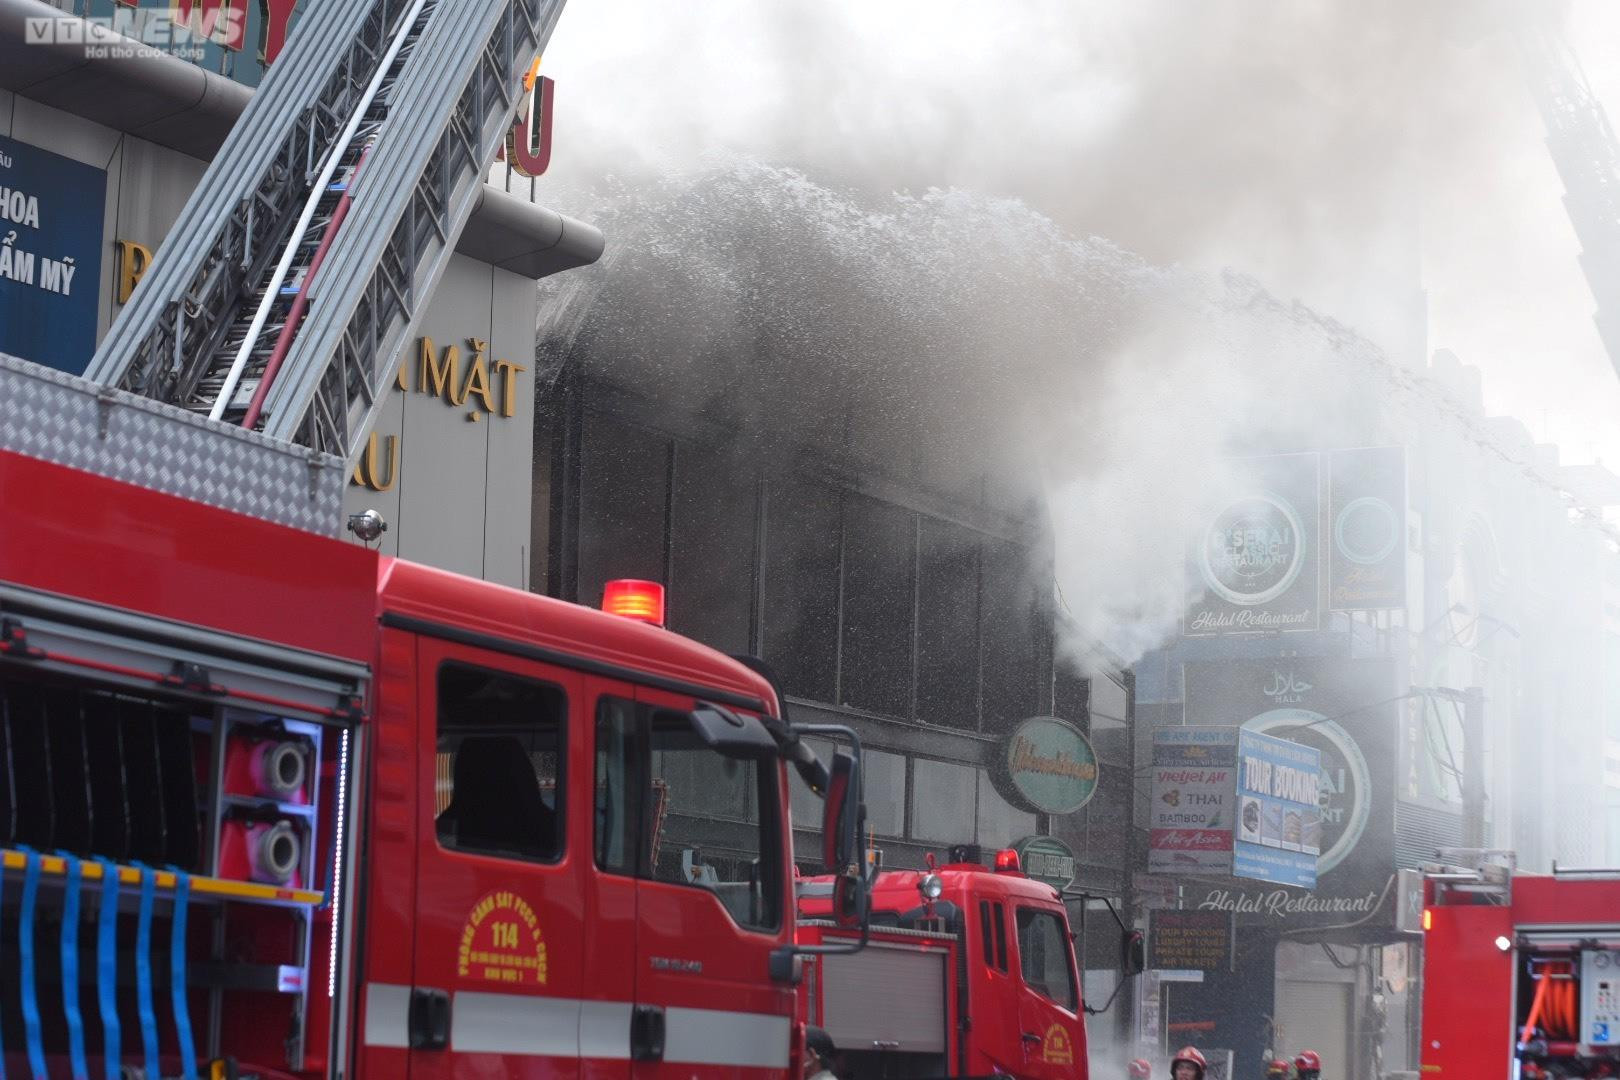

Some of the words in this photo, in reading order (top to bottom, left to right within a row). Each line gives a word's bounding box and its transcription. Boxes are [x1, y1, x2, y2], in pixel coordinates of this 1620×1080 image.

[40, 256, 76, 296] MỸ
[415, 336, 528, 422] MẶT
[1191, 611, 1236, 630] Halal
[1237, 608, 1309, 628] Restaurant
[1245, 756, 1271, 795] TOUR
[1275, 766, 1320, 806] BOOKING
[1186, 794, 1222, 804] THAI
[1160, 813, 1206, 823] BAMBOO
[1198, 890, 1264, 914] Halal
[1266, 890, 1377, 917] Restaurant
[492, 921, 519, 949] 114
